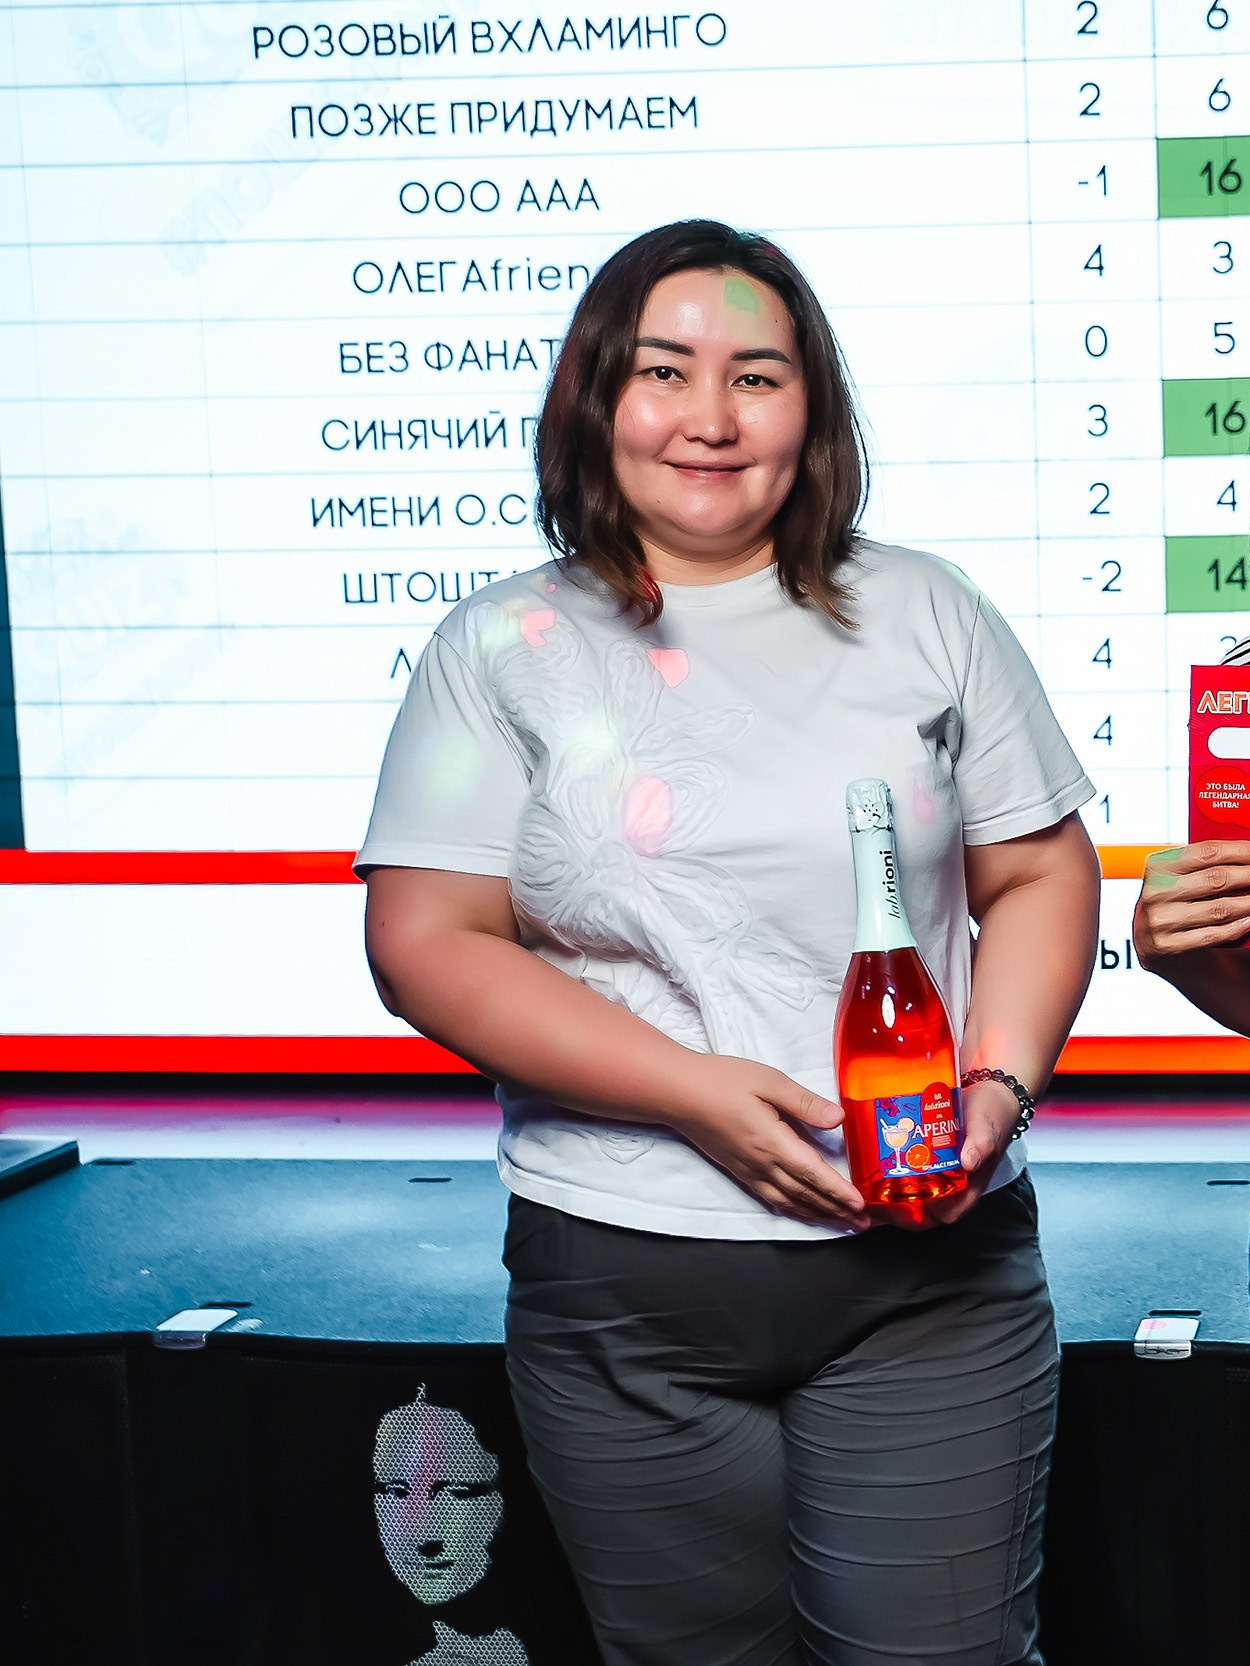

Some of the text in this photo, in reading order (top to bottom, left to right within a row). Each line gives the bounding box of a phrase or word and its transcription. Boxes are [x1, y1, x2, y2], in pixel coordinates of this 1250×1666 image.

[1077, 0, 1098, 35] 2
[1207, 0, 1228, 30] 6
[253, 13, 726, 59] РОЗОВЫЙ ВХЛАМИНГО
[1080, 82, 1100, 116] 2
[1209, 79, 1231, 112] 6
[291, 96, 697, 138] ПОЗЖЕ ПРИДУМАЕМ
[1079, 165, 1106, 196] -1
[1200, 159, 1243, 196] 16
[399, 178, 599, 214] ООО ААА
[1084, 244, 1104, 276] 4
[1213, 241, 1233, 274] 3
[353, 257, 589, 293] ОЛЕГАfrien
[1085, 326, 1107, 357] 0
[1214, 322, 1235, 354] 5
[340, 339, 561, 373] БЕЗ ФАНАТ
[322, 411, 507, 451] СИНЯЧИЙ
[1088, 404, 1108, 437] 3
[1205, 401, 1246, 436] 16
[311, 496, 440, 527] ИМЕНИ
[1090, 483, 1110, 514] 2
[1217, 480, 1237, 512] 4
[343, 571, 517, 603] ШТОШТ
[1083, 560, 1121, 592] -2
[1207, 557, 1247, 592] 14
[1092, 638, 1112, 669] 4
[1093, 715, 1112, 745] 4
[1205, 782, 1246, 791] ЭТО БЫЛА
[1212, 801, 1239, 809] БИТВА!
